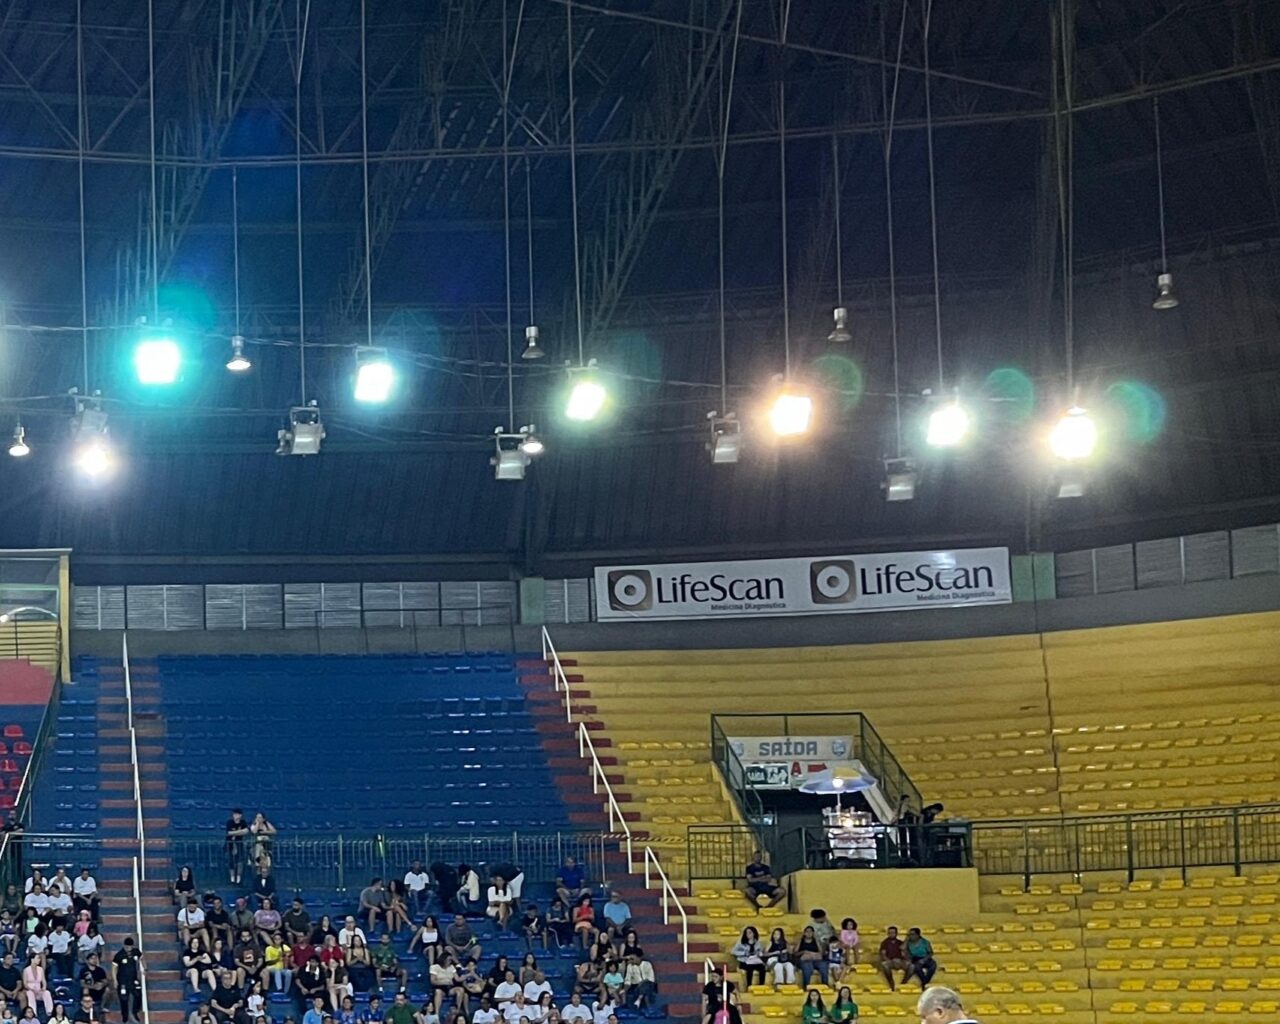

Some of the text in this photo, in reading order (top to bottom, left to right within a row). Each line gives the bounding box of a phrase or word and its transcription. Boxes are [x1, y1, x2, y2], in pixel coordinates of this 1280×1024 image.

[656, 574, 785, 604] LifeScan
[860, 564, 994, 596] LifeScan
[758, 738, 818, 756] SAÍDA
